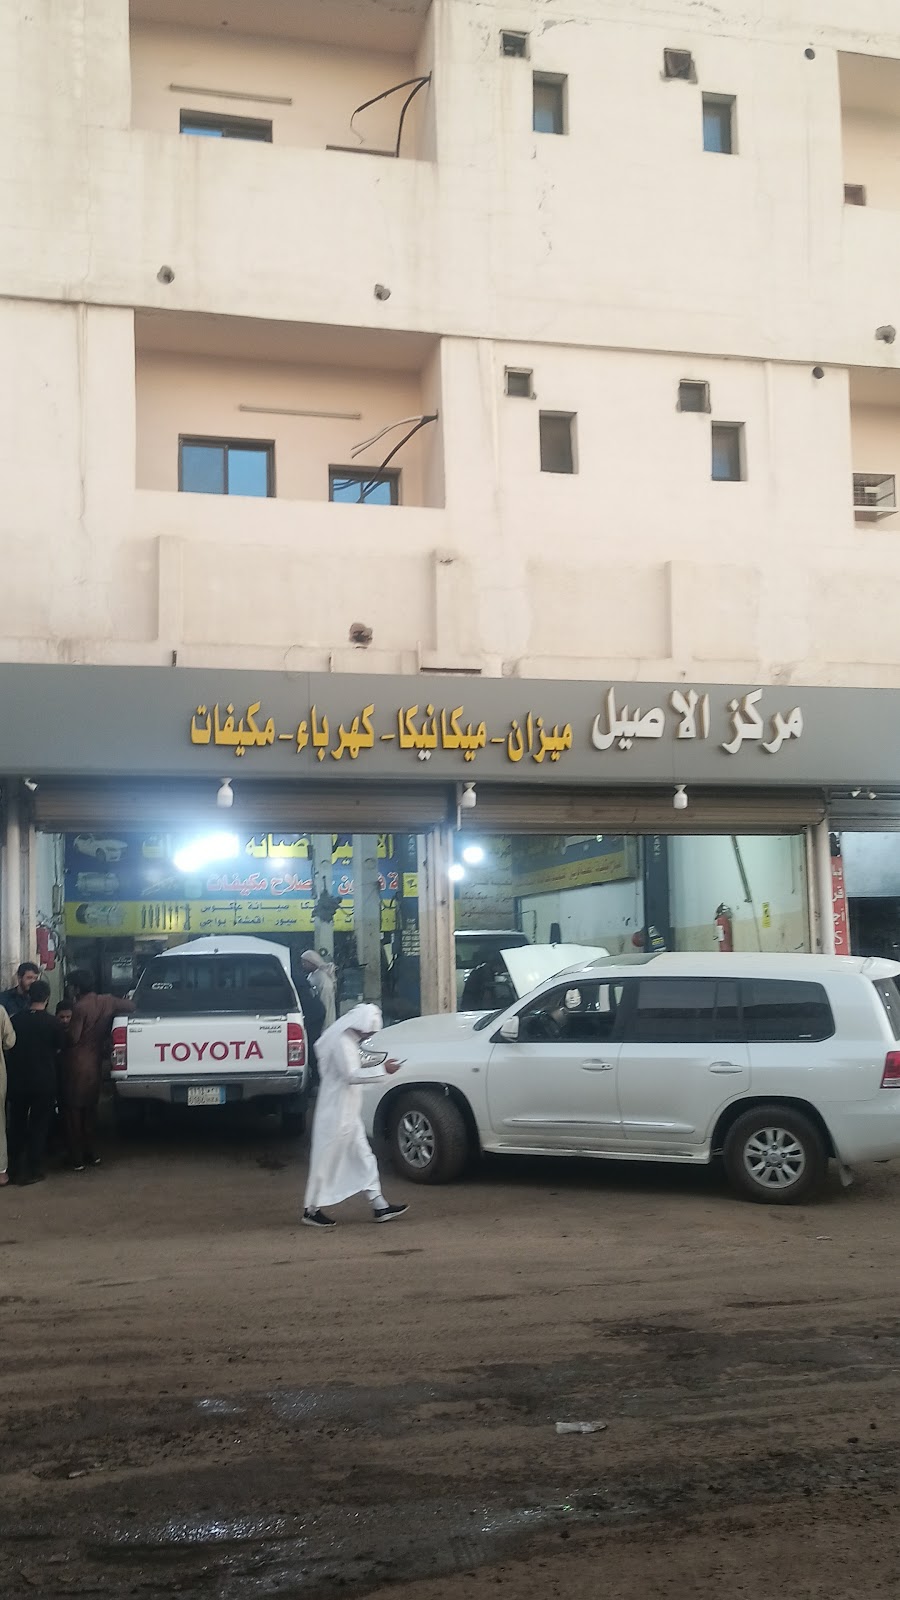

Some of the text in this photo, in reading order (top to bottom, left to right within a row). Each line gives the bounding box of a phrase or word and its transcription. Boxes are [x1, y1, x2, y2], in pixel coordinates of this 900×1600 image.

[190, 701, 574, 763] ميزان ميكانيكا كهرباء مكيفات
[592, 686, 804, 754] مركز الاصيل
[207, 872, 268, 897] مكيفات
[154, 1041, 264, 1062] TOYOTA
